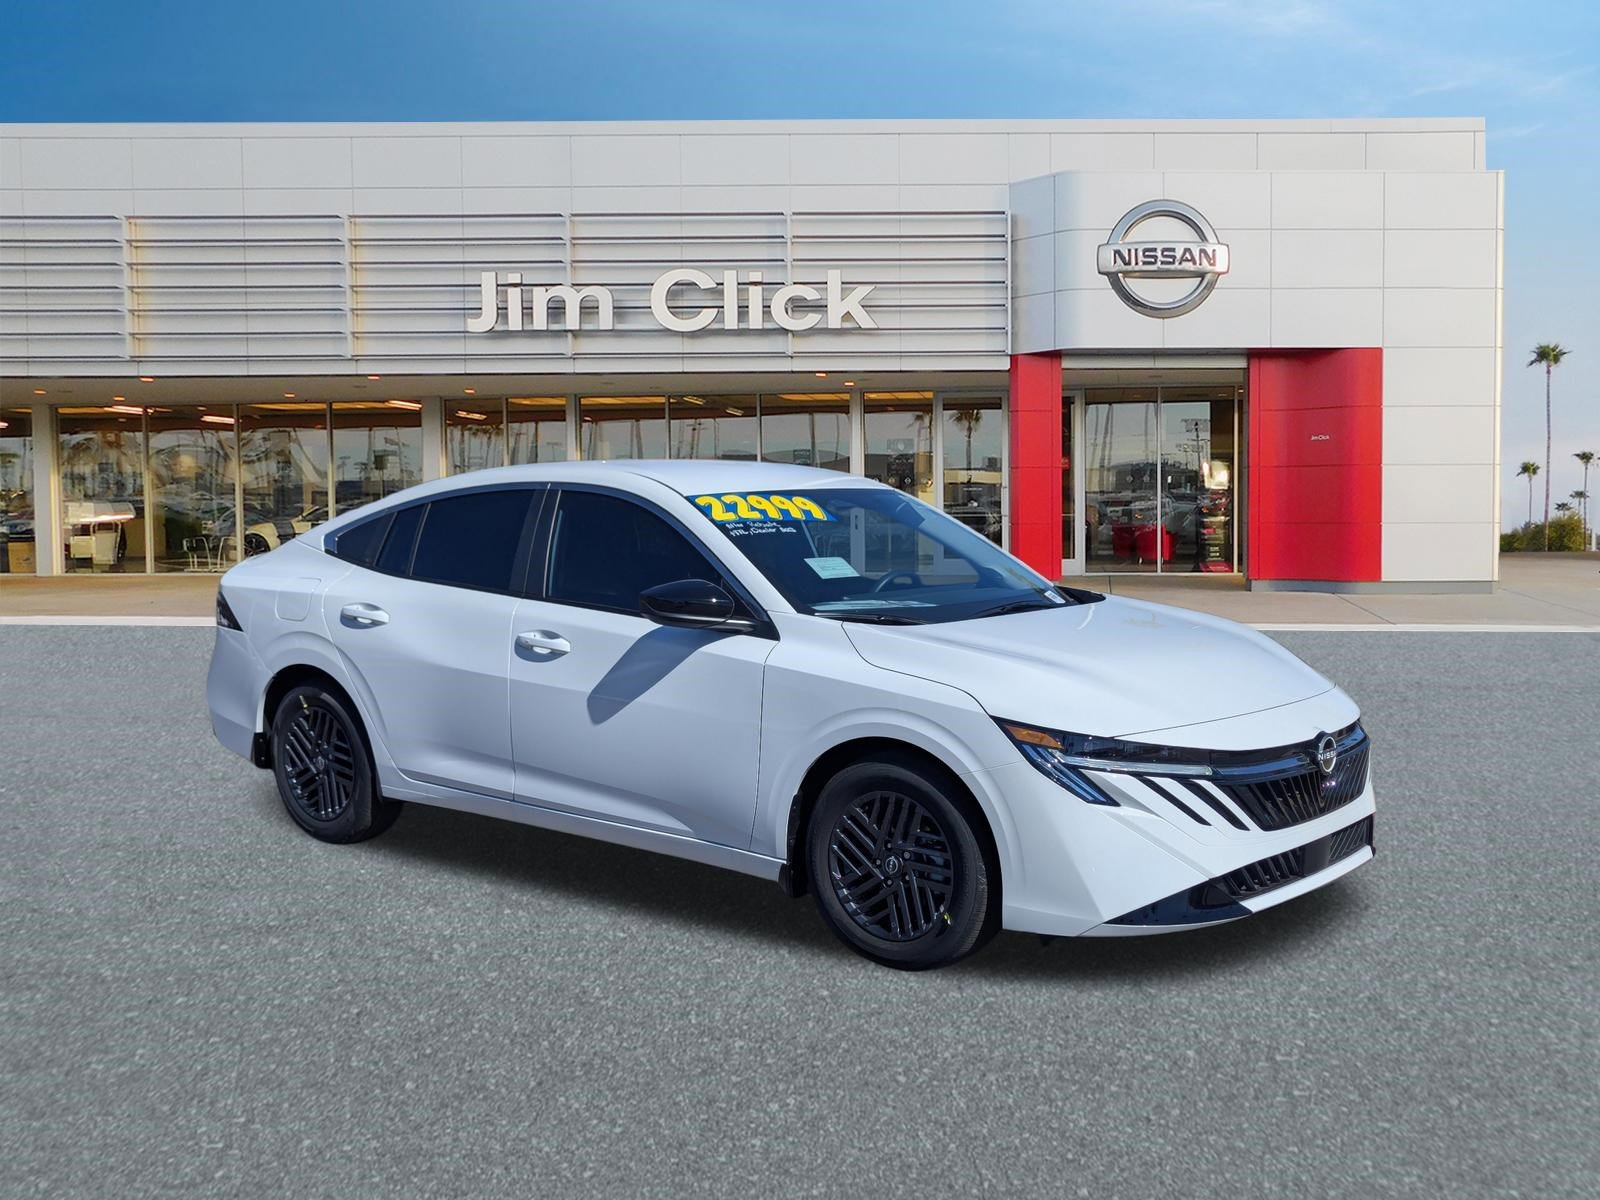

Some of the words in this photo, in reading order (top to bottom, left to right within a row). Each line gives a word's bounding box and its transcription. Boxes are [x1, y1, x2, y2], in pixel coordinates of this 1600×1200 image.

[1112, 247, 1217, 267] NISSAN
[467, 271, 614, 333] Jim
[650, 268, 879, 333] Click
[695, 495, 827, 521] 22999
[1318, 750, 1336, 760] NISS
